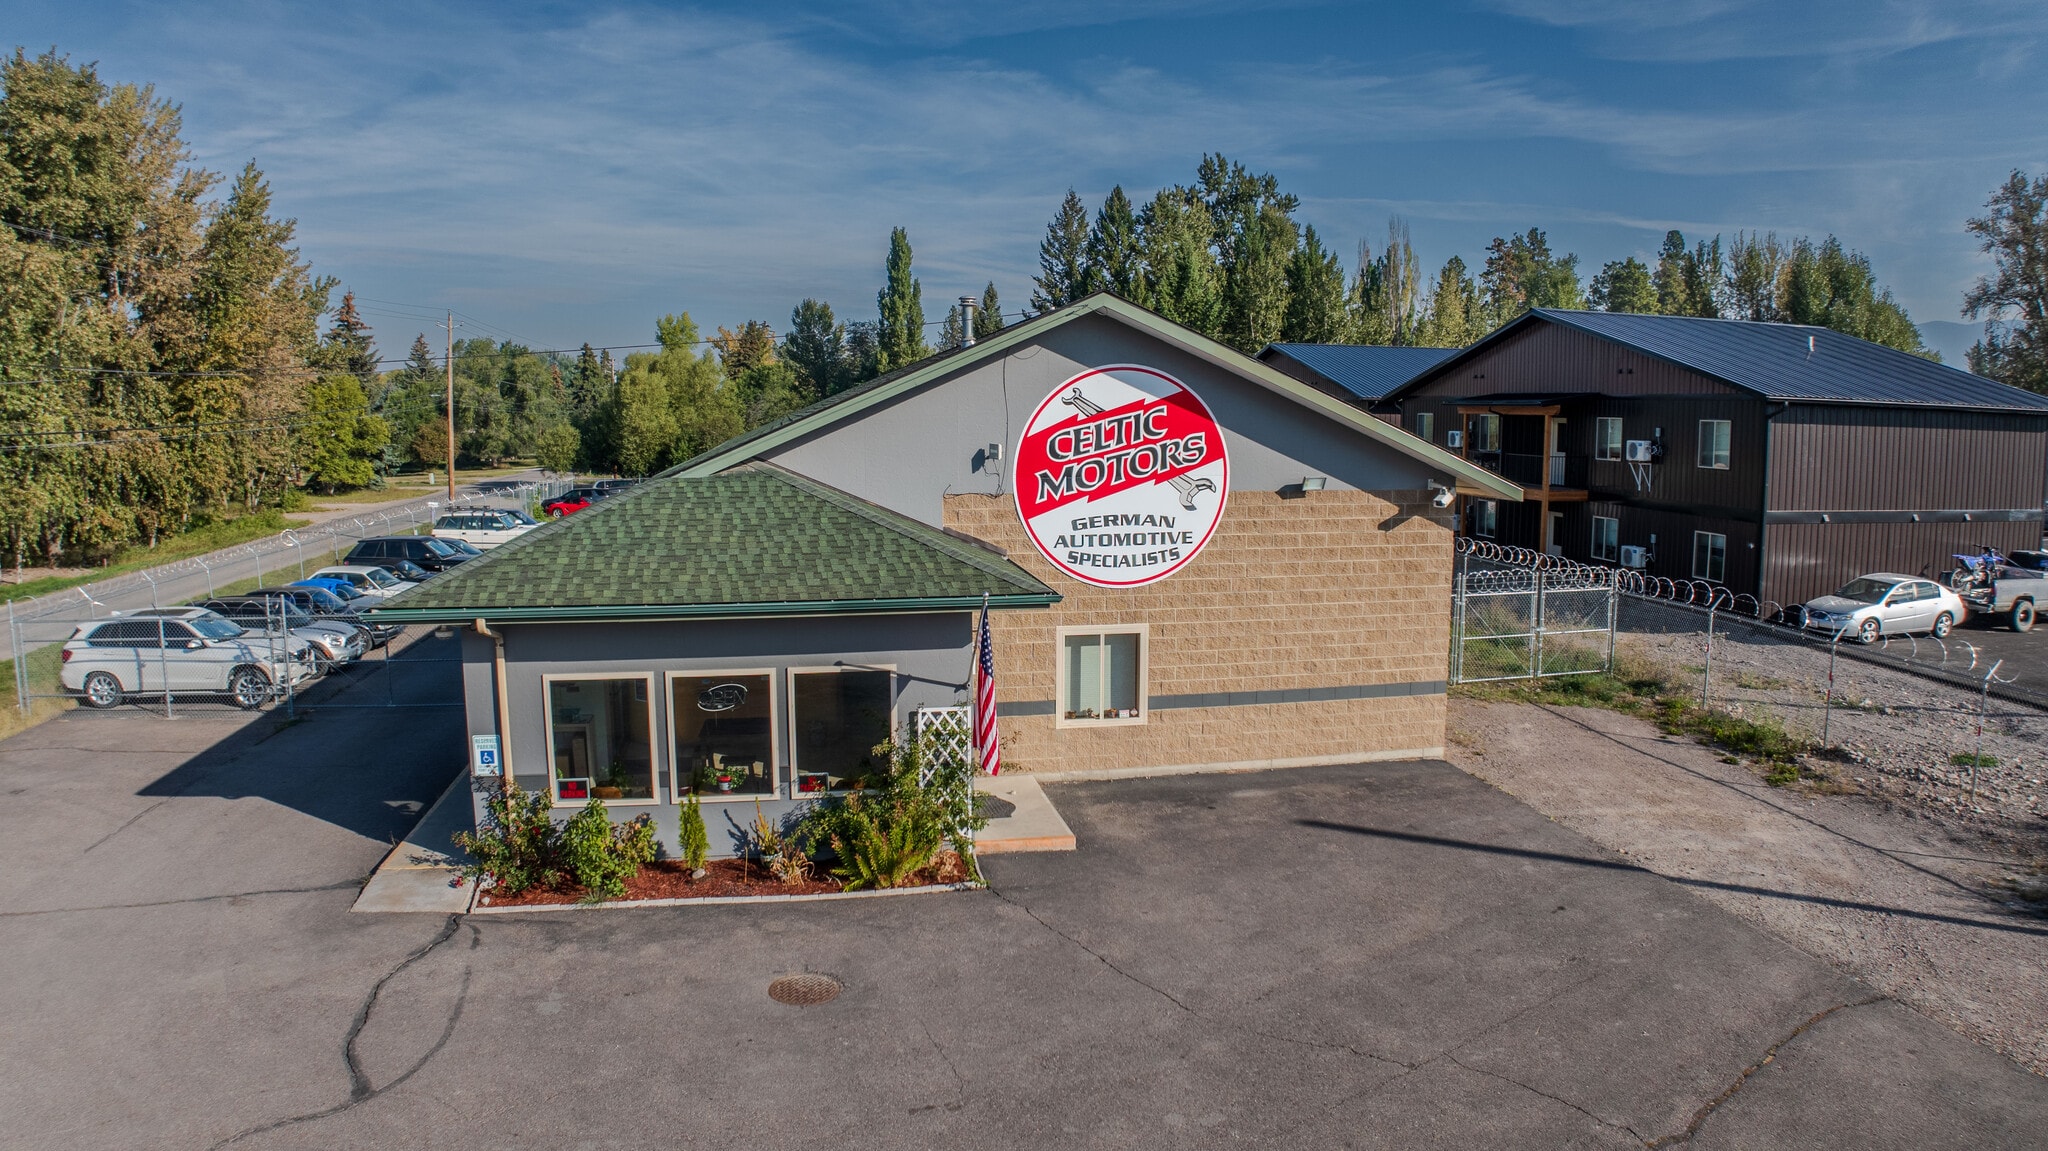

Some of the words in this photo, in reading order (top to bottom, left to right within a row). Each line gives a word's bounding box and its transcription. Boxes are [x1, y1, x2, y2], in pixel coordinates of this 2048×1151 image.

[1047, 405, 1168, 462] CELTIC
[1035, 432, 1206, 504] MOTORS
[1071, 513, 1176, 531] GERMAN
[1053, 531, 1193, 548] AUTOMOTIVE
[1067, 547, 1180, 568] SPECIALISTS
[698, 690, 746, 706] OPEN
